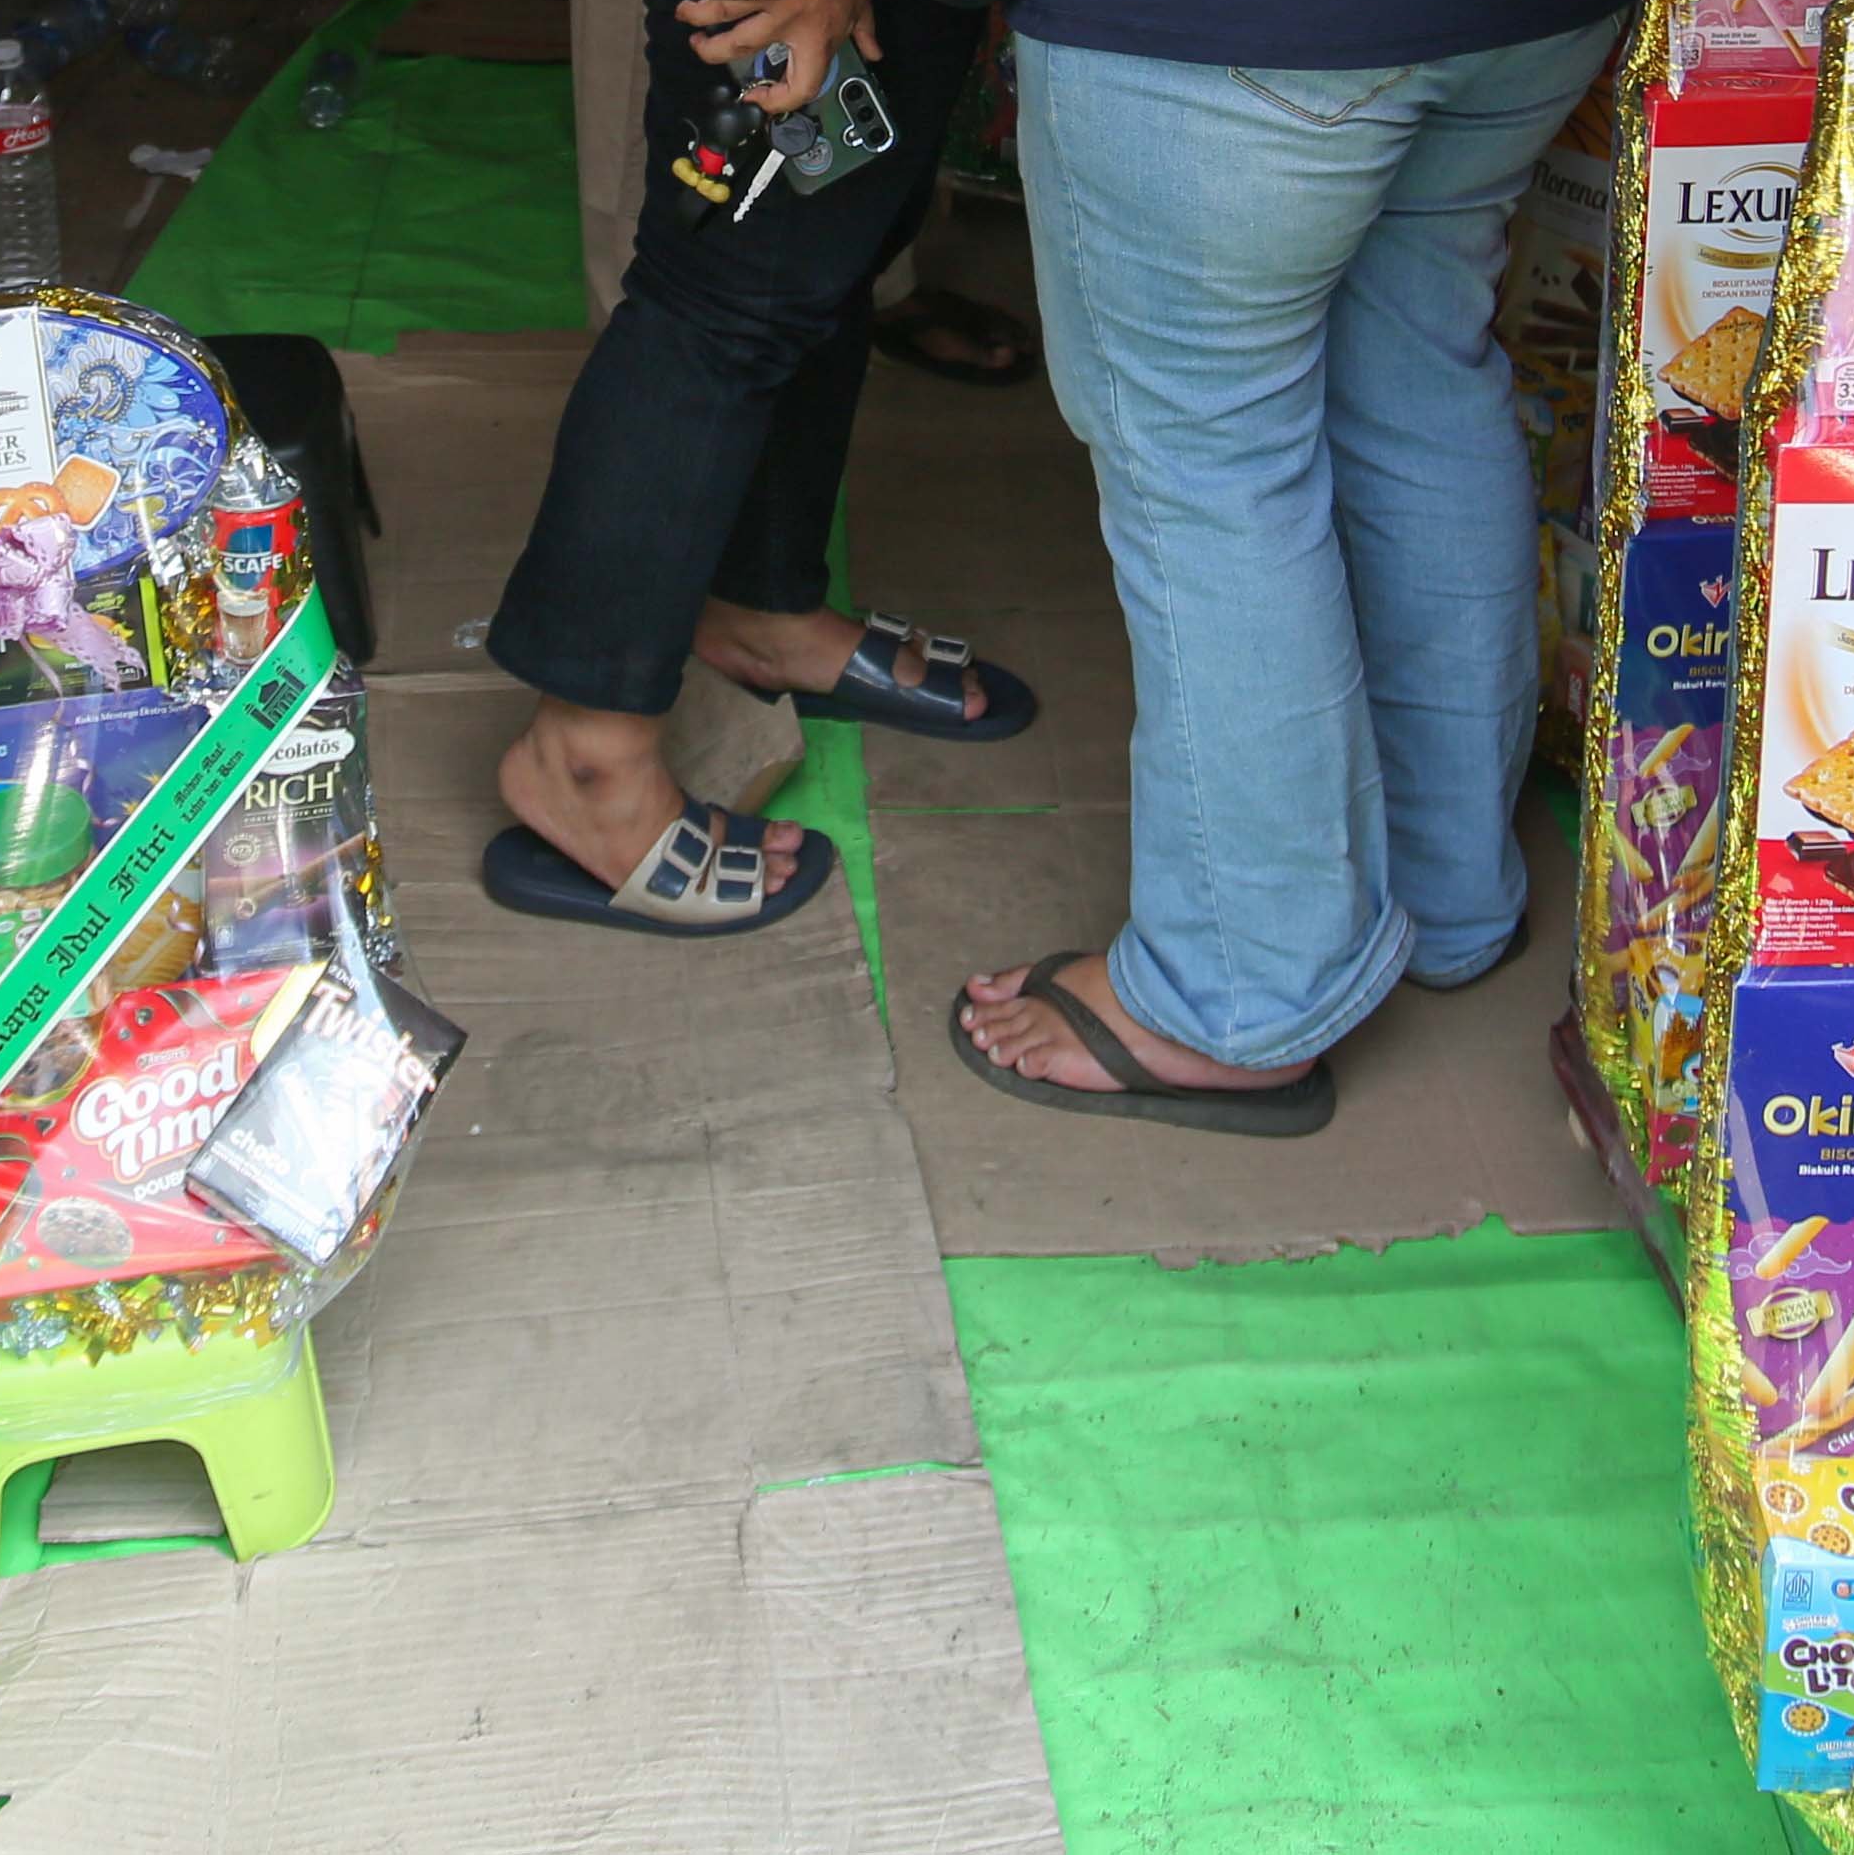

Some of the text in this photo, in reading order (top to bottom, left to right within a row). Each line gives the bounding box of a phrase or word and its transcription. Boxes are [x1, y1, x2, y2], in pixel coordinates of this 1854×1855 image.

[243, 774, 337, 812] RICH
[45, 902, 114, 977] Idul
[107, 822, 177, 905] Fitri
[74, 1042, 240, 1141] Good
